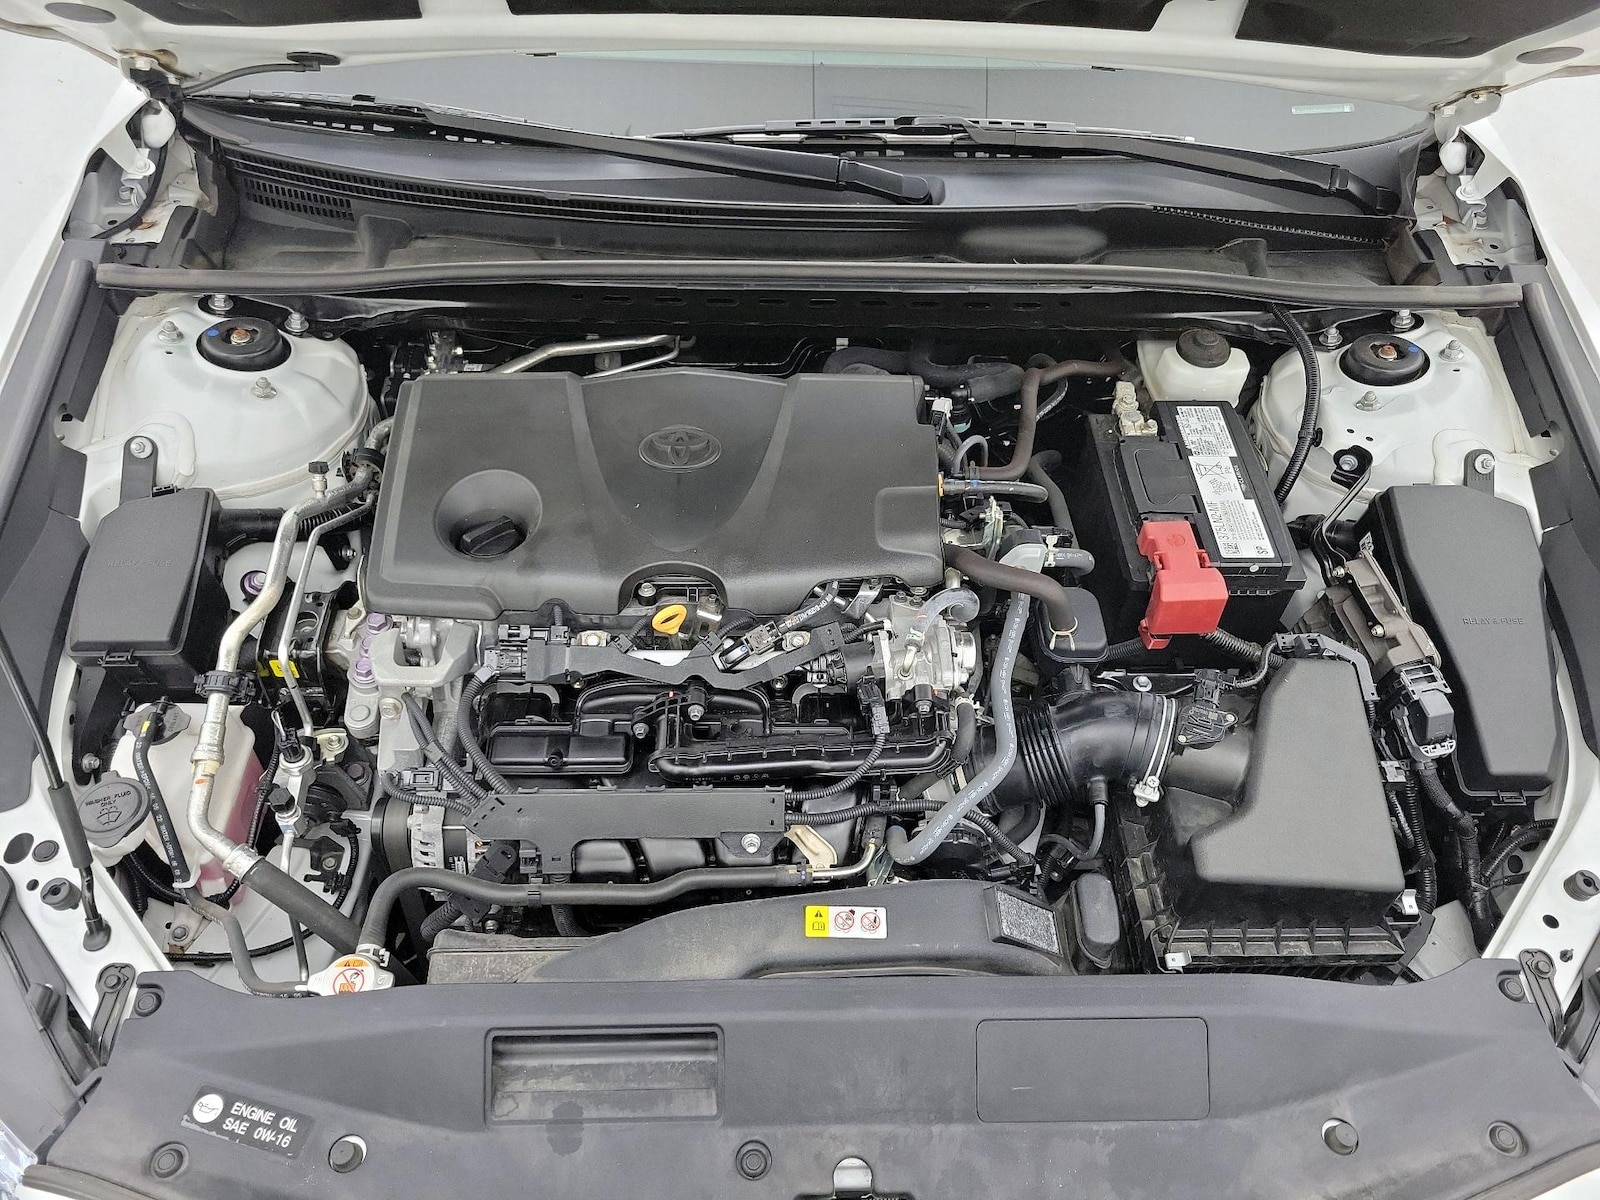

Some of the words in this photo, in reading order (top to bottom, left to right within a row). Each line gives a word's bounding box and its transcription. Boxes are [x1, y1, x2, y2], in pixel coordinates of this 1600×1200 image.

[1255, 545, 1269, 555] SP
[1462, 617, 1490, 625] RELAY
[1500, 617, 1525, 625] FUSE
[100, 799, 117, 807] ONLY
[230, 1102, 276, 1125] ENGINE
[279, 1116, 299, 1133] OIL
[222, 1117, 250, 1135] SAE
[253, 1127, 292, 1148] 0W-16
